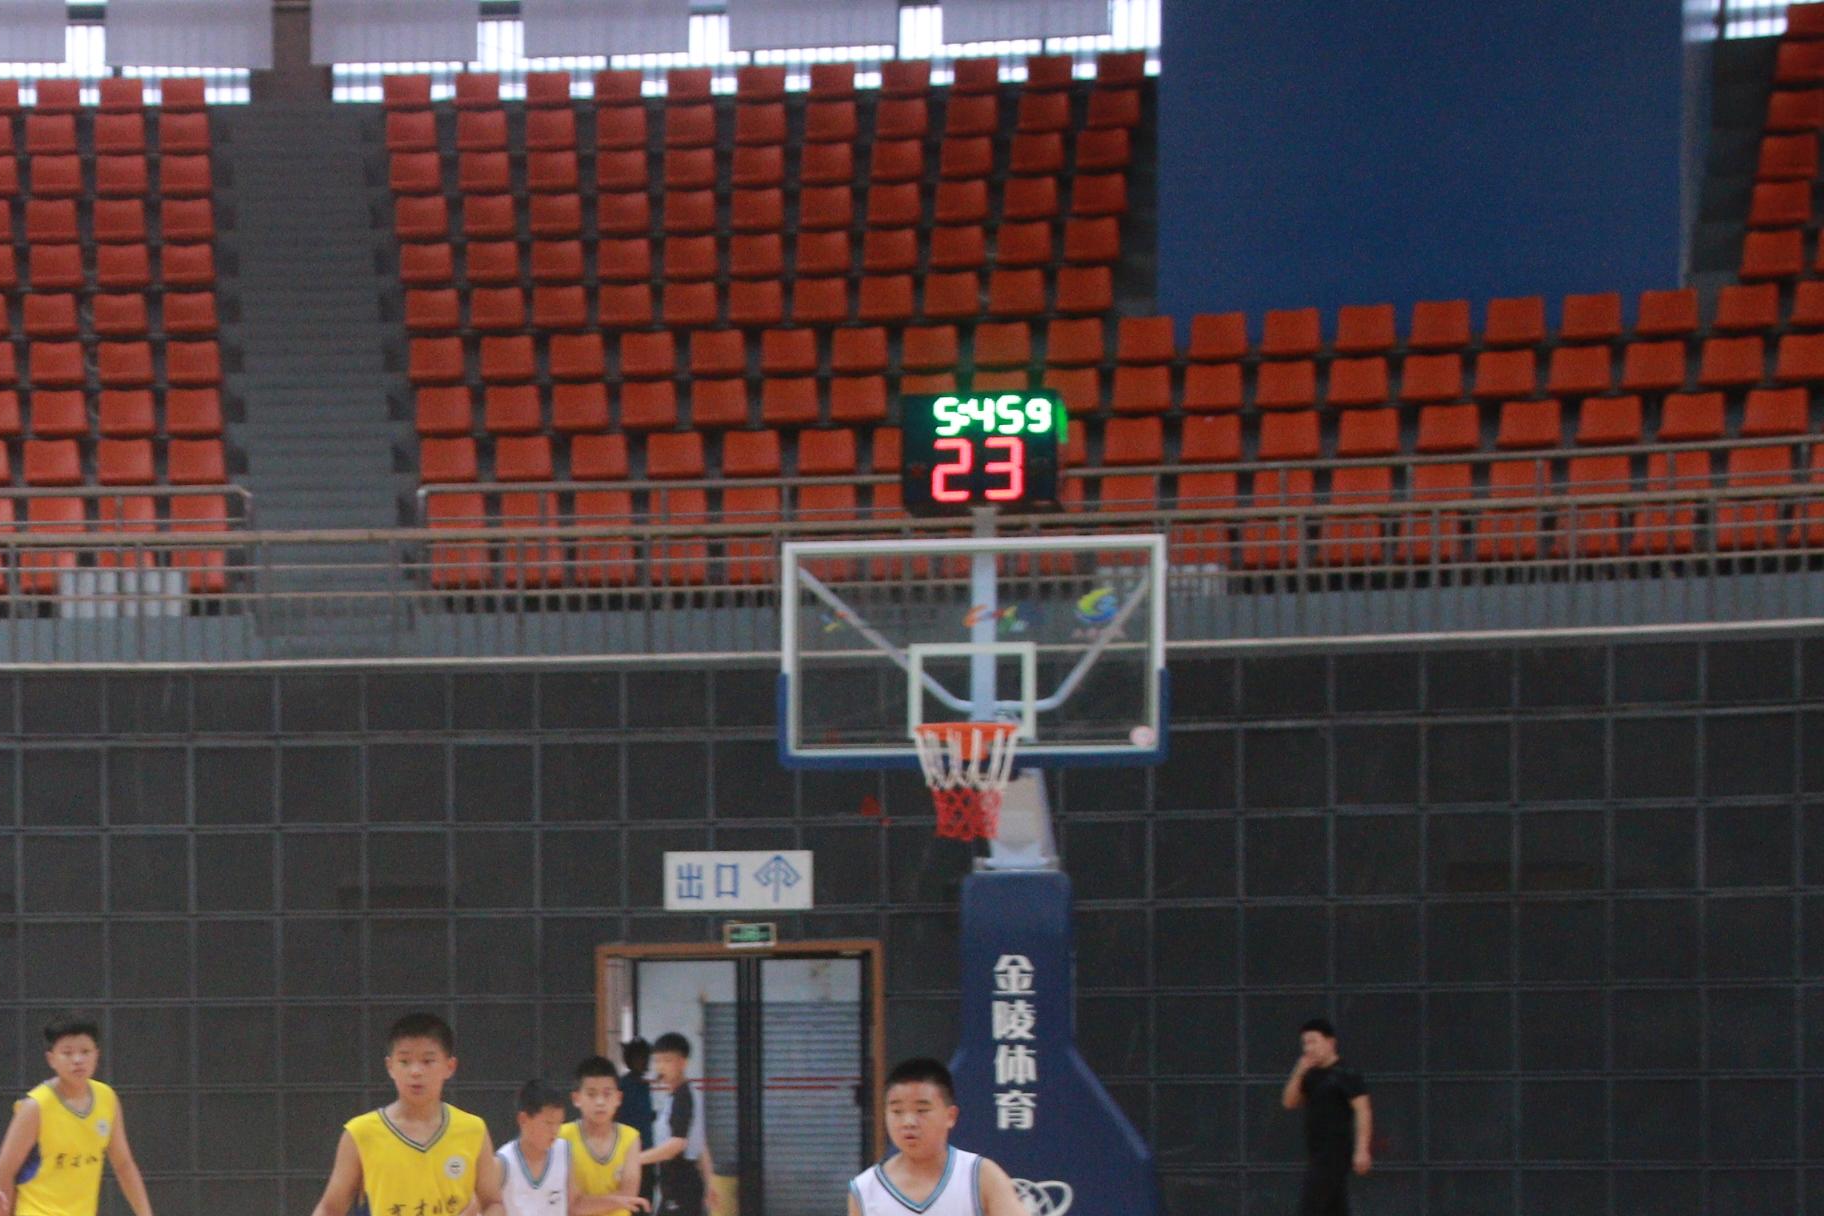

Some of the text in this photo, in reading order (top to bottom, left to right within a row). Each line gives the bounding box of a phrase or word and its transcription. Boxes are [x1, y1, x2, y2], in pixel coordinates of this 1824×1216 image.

[933, 437, 1025, 502] 23
[677, 863, 740, 900] 出口
[991, 954, 1037, 1130] 金陵体育
